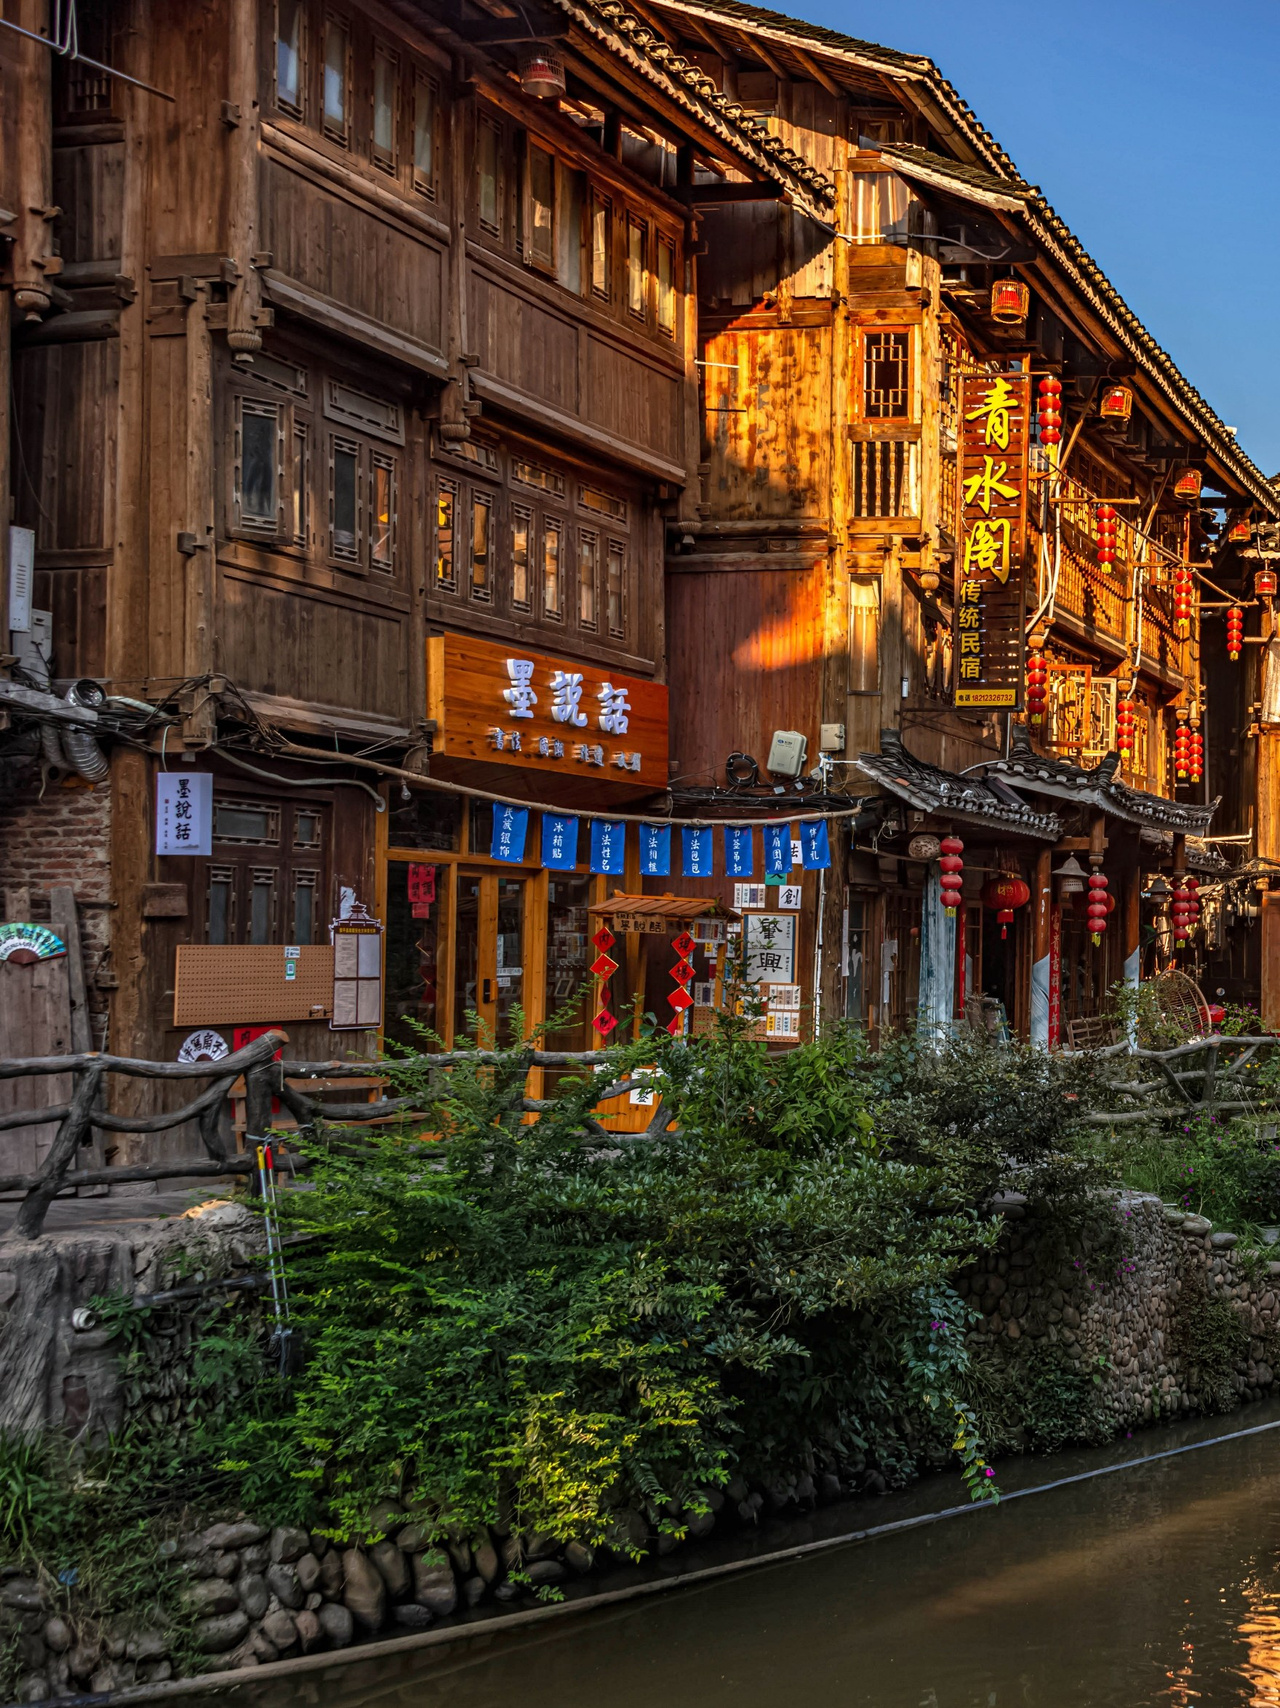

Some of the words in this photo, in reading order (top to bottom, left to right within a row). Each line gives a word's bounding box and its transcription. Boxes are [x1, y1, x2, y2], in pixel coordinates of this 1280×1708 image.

[959, 581, 982, 679] 传统民宿
[781, 887, 800, 906] 創
